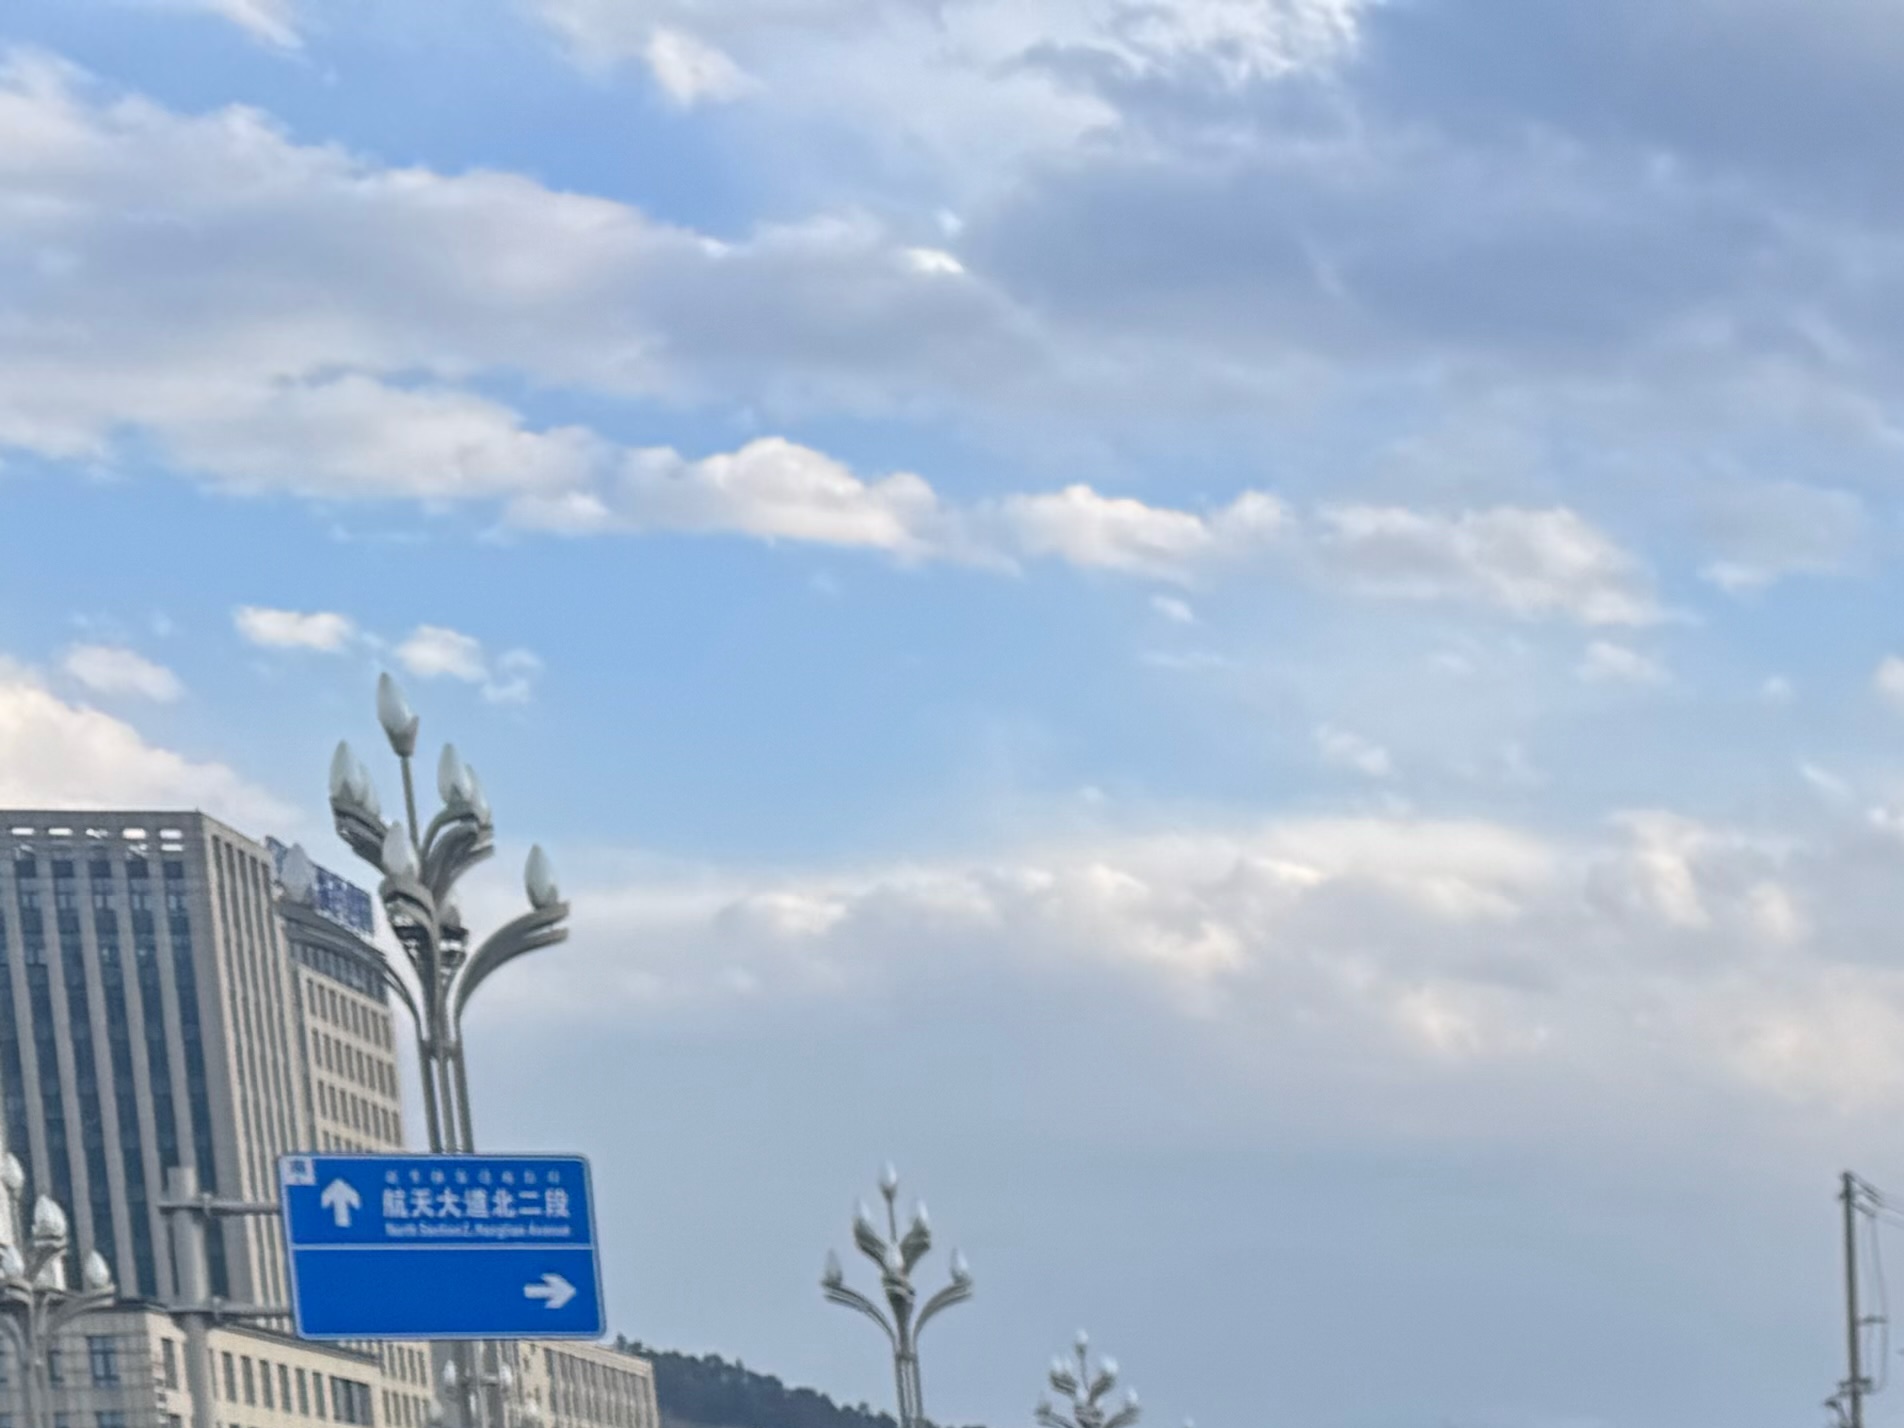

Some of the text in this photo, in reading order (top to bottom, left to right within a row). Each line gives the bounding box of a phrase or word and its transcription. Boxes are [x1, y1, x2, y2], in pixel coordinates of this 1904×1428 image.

[383, 1187, 570, 1218] 航天大道北二段
